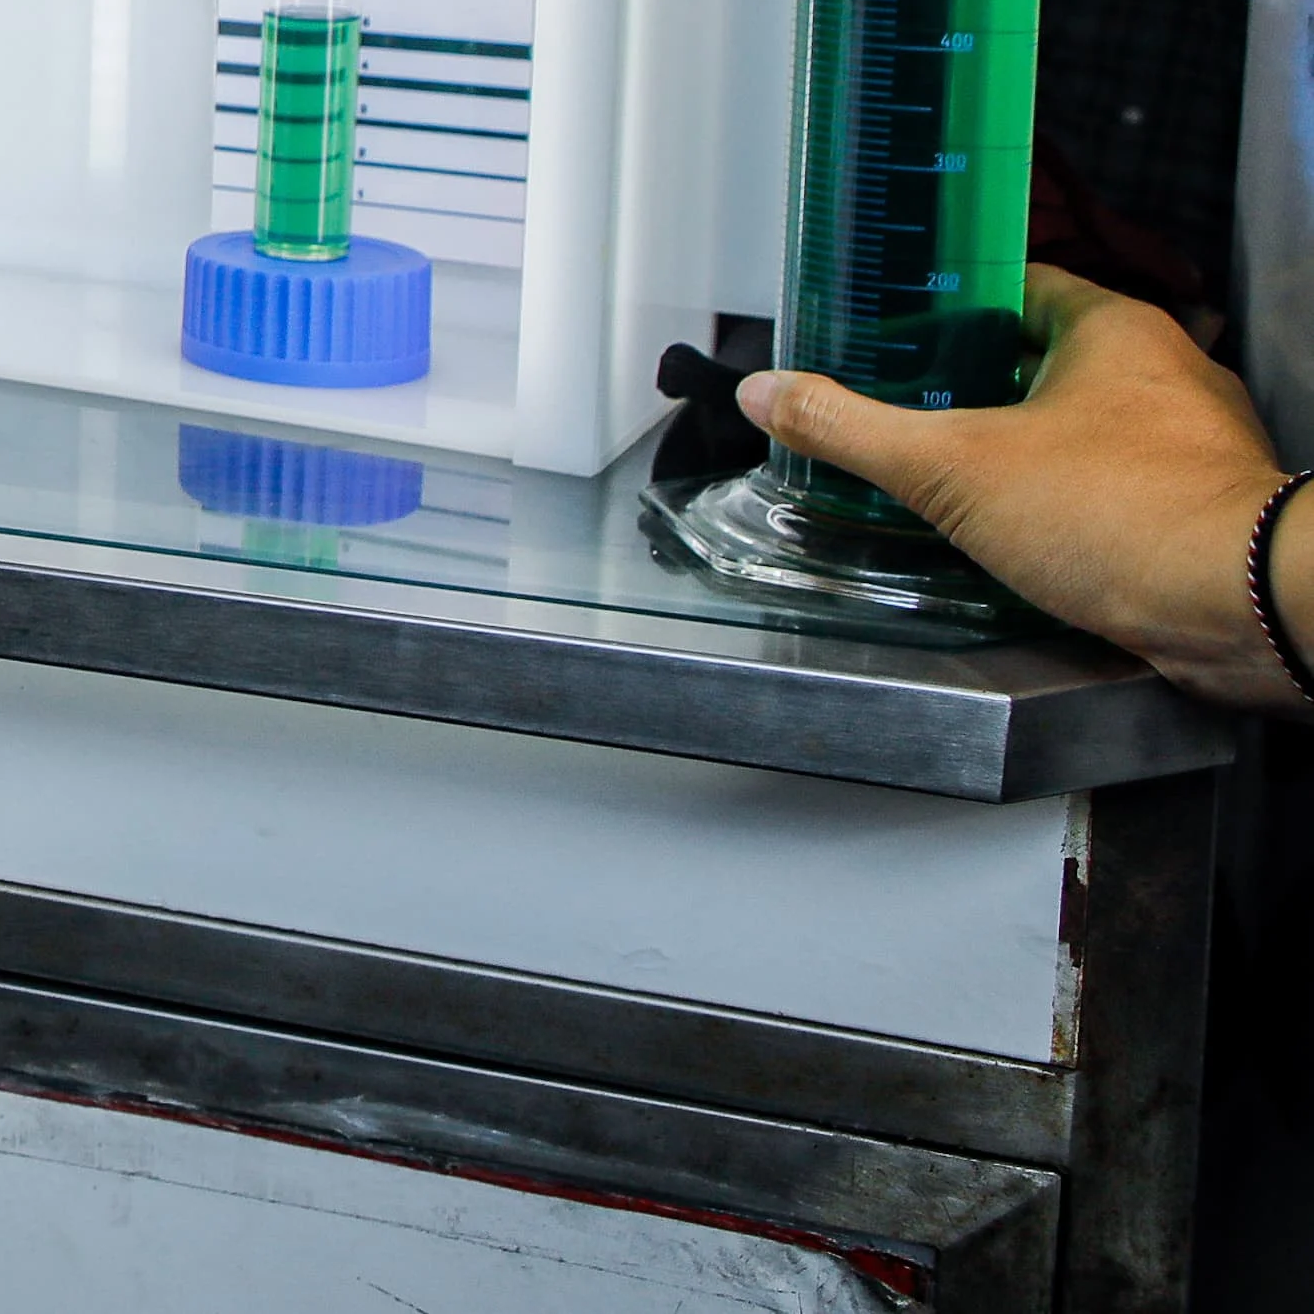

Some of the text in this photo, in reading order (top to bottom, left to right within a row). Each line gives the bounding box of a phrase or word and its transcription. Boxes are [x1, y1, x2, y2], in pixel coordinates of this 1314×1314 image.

[940, 32, 974, 49] 400
[933, 152, 967, 169] 300
[926, 271, 960, 288] 200
[921, 390, 952, 407] 100
